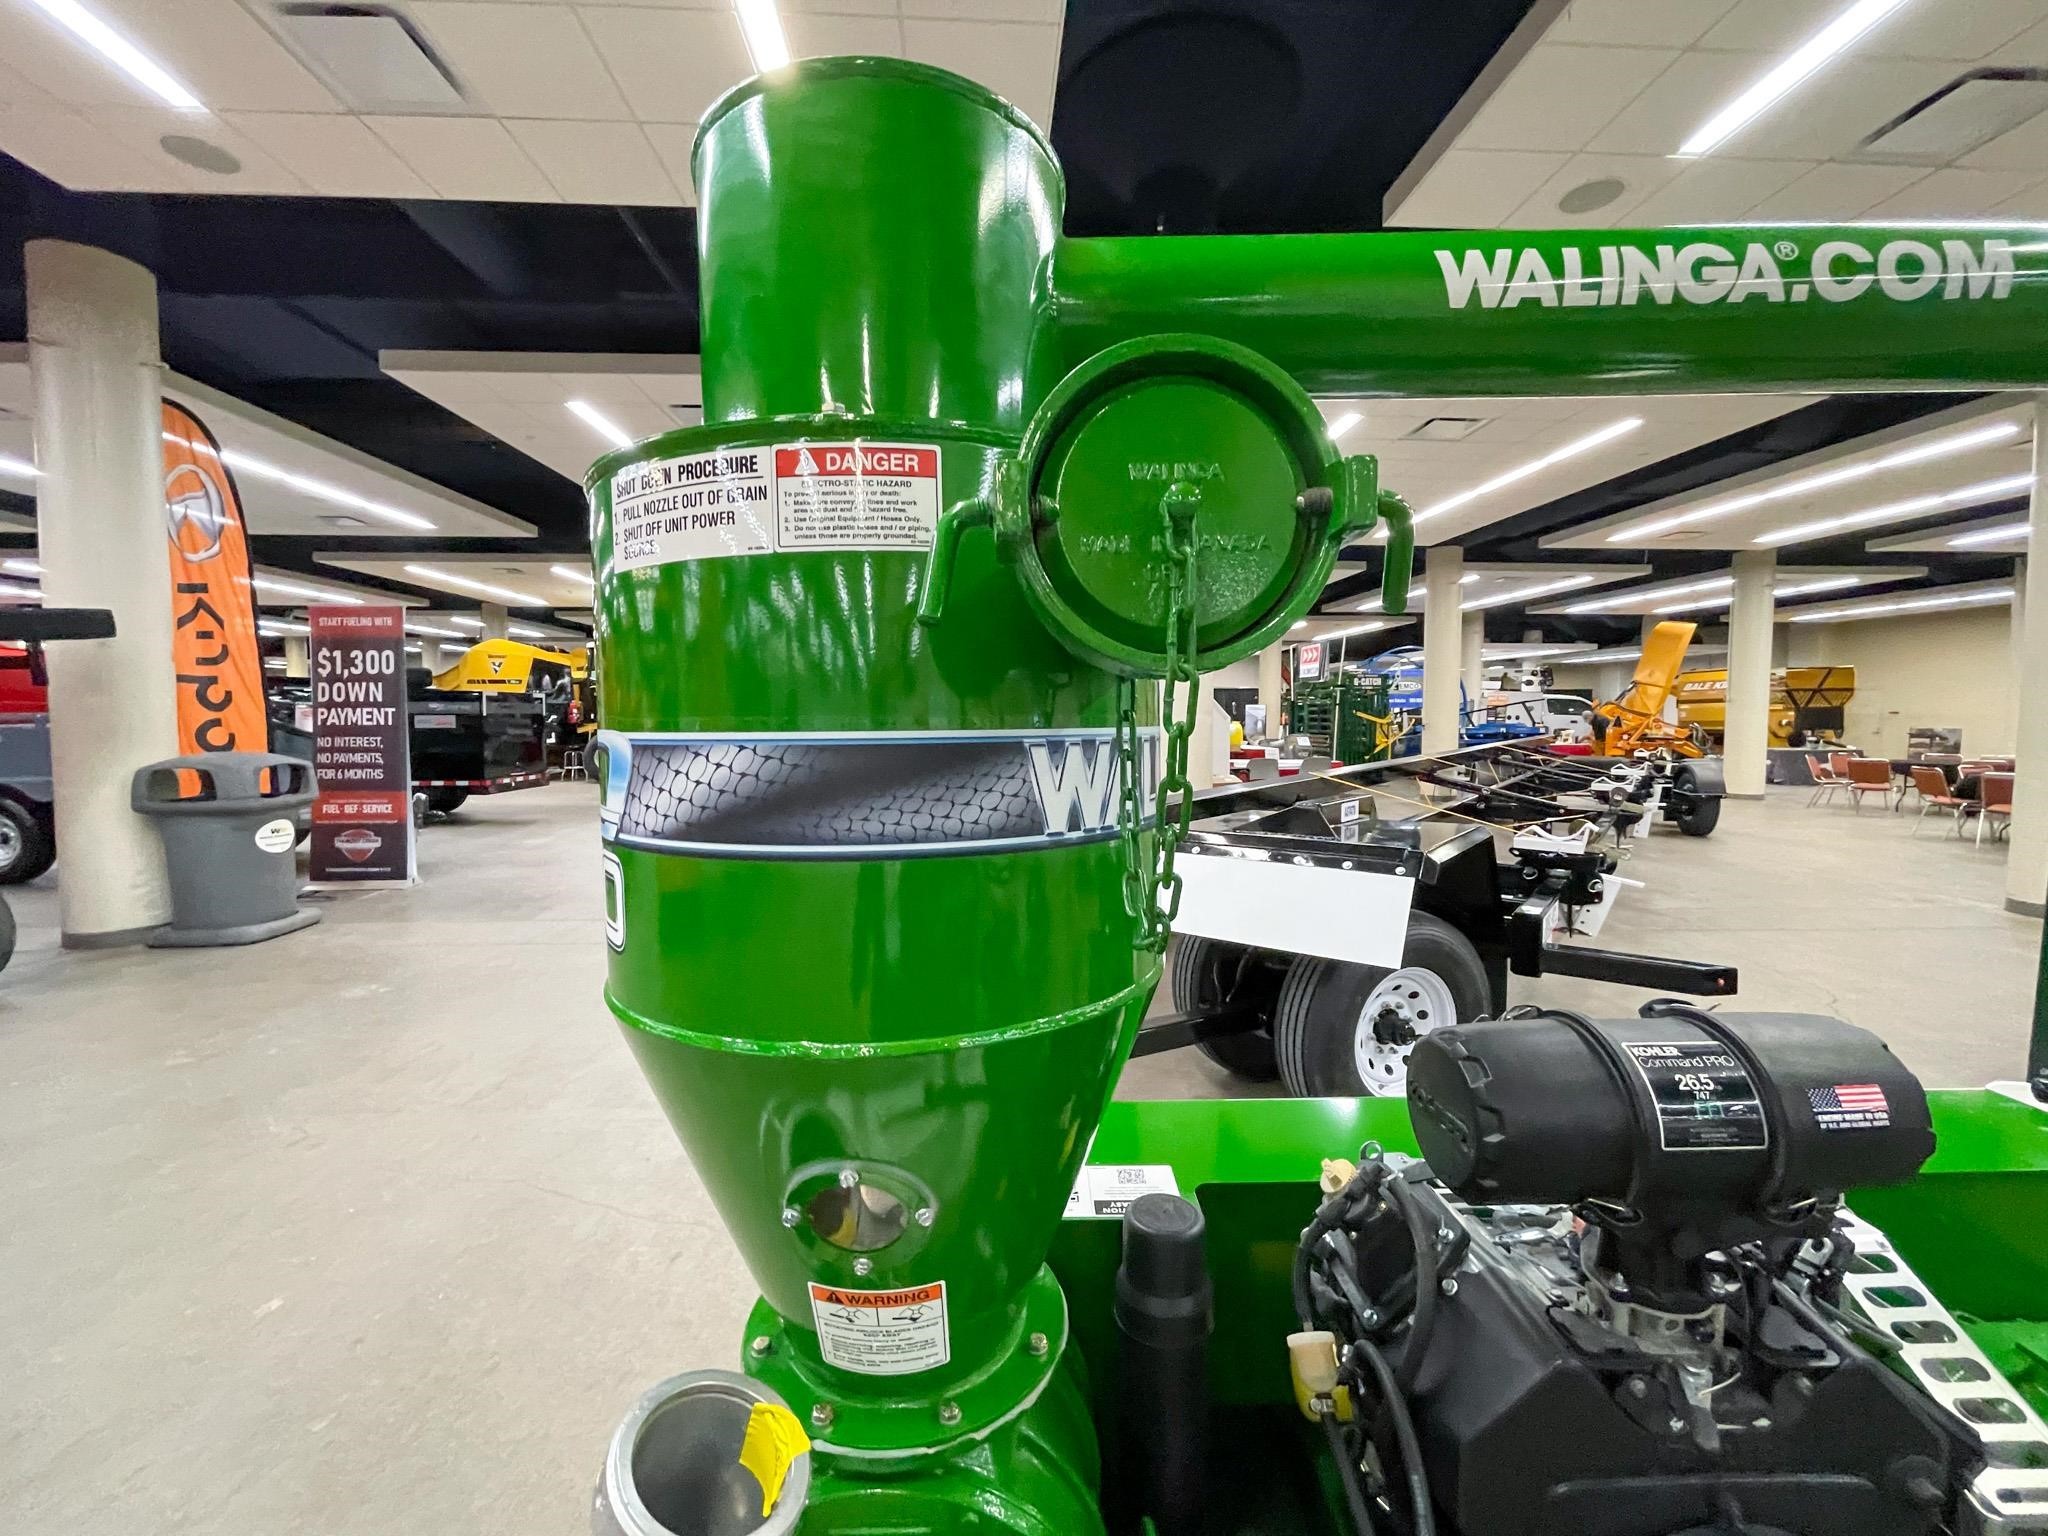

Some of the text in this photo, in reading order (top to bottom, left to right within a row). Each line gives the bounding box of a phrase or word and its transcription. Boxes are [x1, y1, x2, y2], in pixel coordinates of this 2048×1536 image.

[826, 452, 919, 472] DANGER
[616, 479, 636, 498] SHUT
[801, 480, 912, 488] ELCTRO-STTIC HAZARD
[794, 490, 819, 498] prevt
[623, 504, 642, 522] PULL
[643, 496, 679, 519] NOZZLE
[682, 491, 704, 509] OUT
[708, 489, 724, 506] OF
[727, 485, 768, 504] GRAIN
[837, 515, 875, 523] Equipent
[615, 510, 736, 546] 2. SHUT OFF UNIT POWER
[319, 617, 342, 626] START
[374, 617, 393, 626] WITH
[317, 647, 395, 679] $1,300
[317, 682, 383, 702] DOWN
[317, 707, 396, 726] PAYMENT
[317, 736, 383, 749] NO INTEREST,
[317, 752, 384, 764] NO PAYMENTS,
[317, 768, 384, 779] FOR 6 MONTHS
[322, 804, 340, 814] FUEL
[362, 804, 393, 813] SERVICE
[1630, 1046, 1683, 1057] KOHLER
[1638, 1055, 1735, 1068] Command PRO
[1674, 1073, 1715, 1091] 26.5
[1693, 1091, 1710, 1100] 747
[845, 1291, 930, 1305] WARNING
